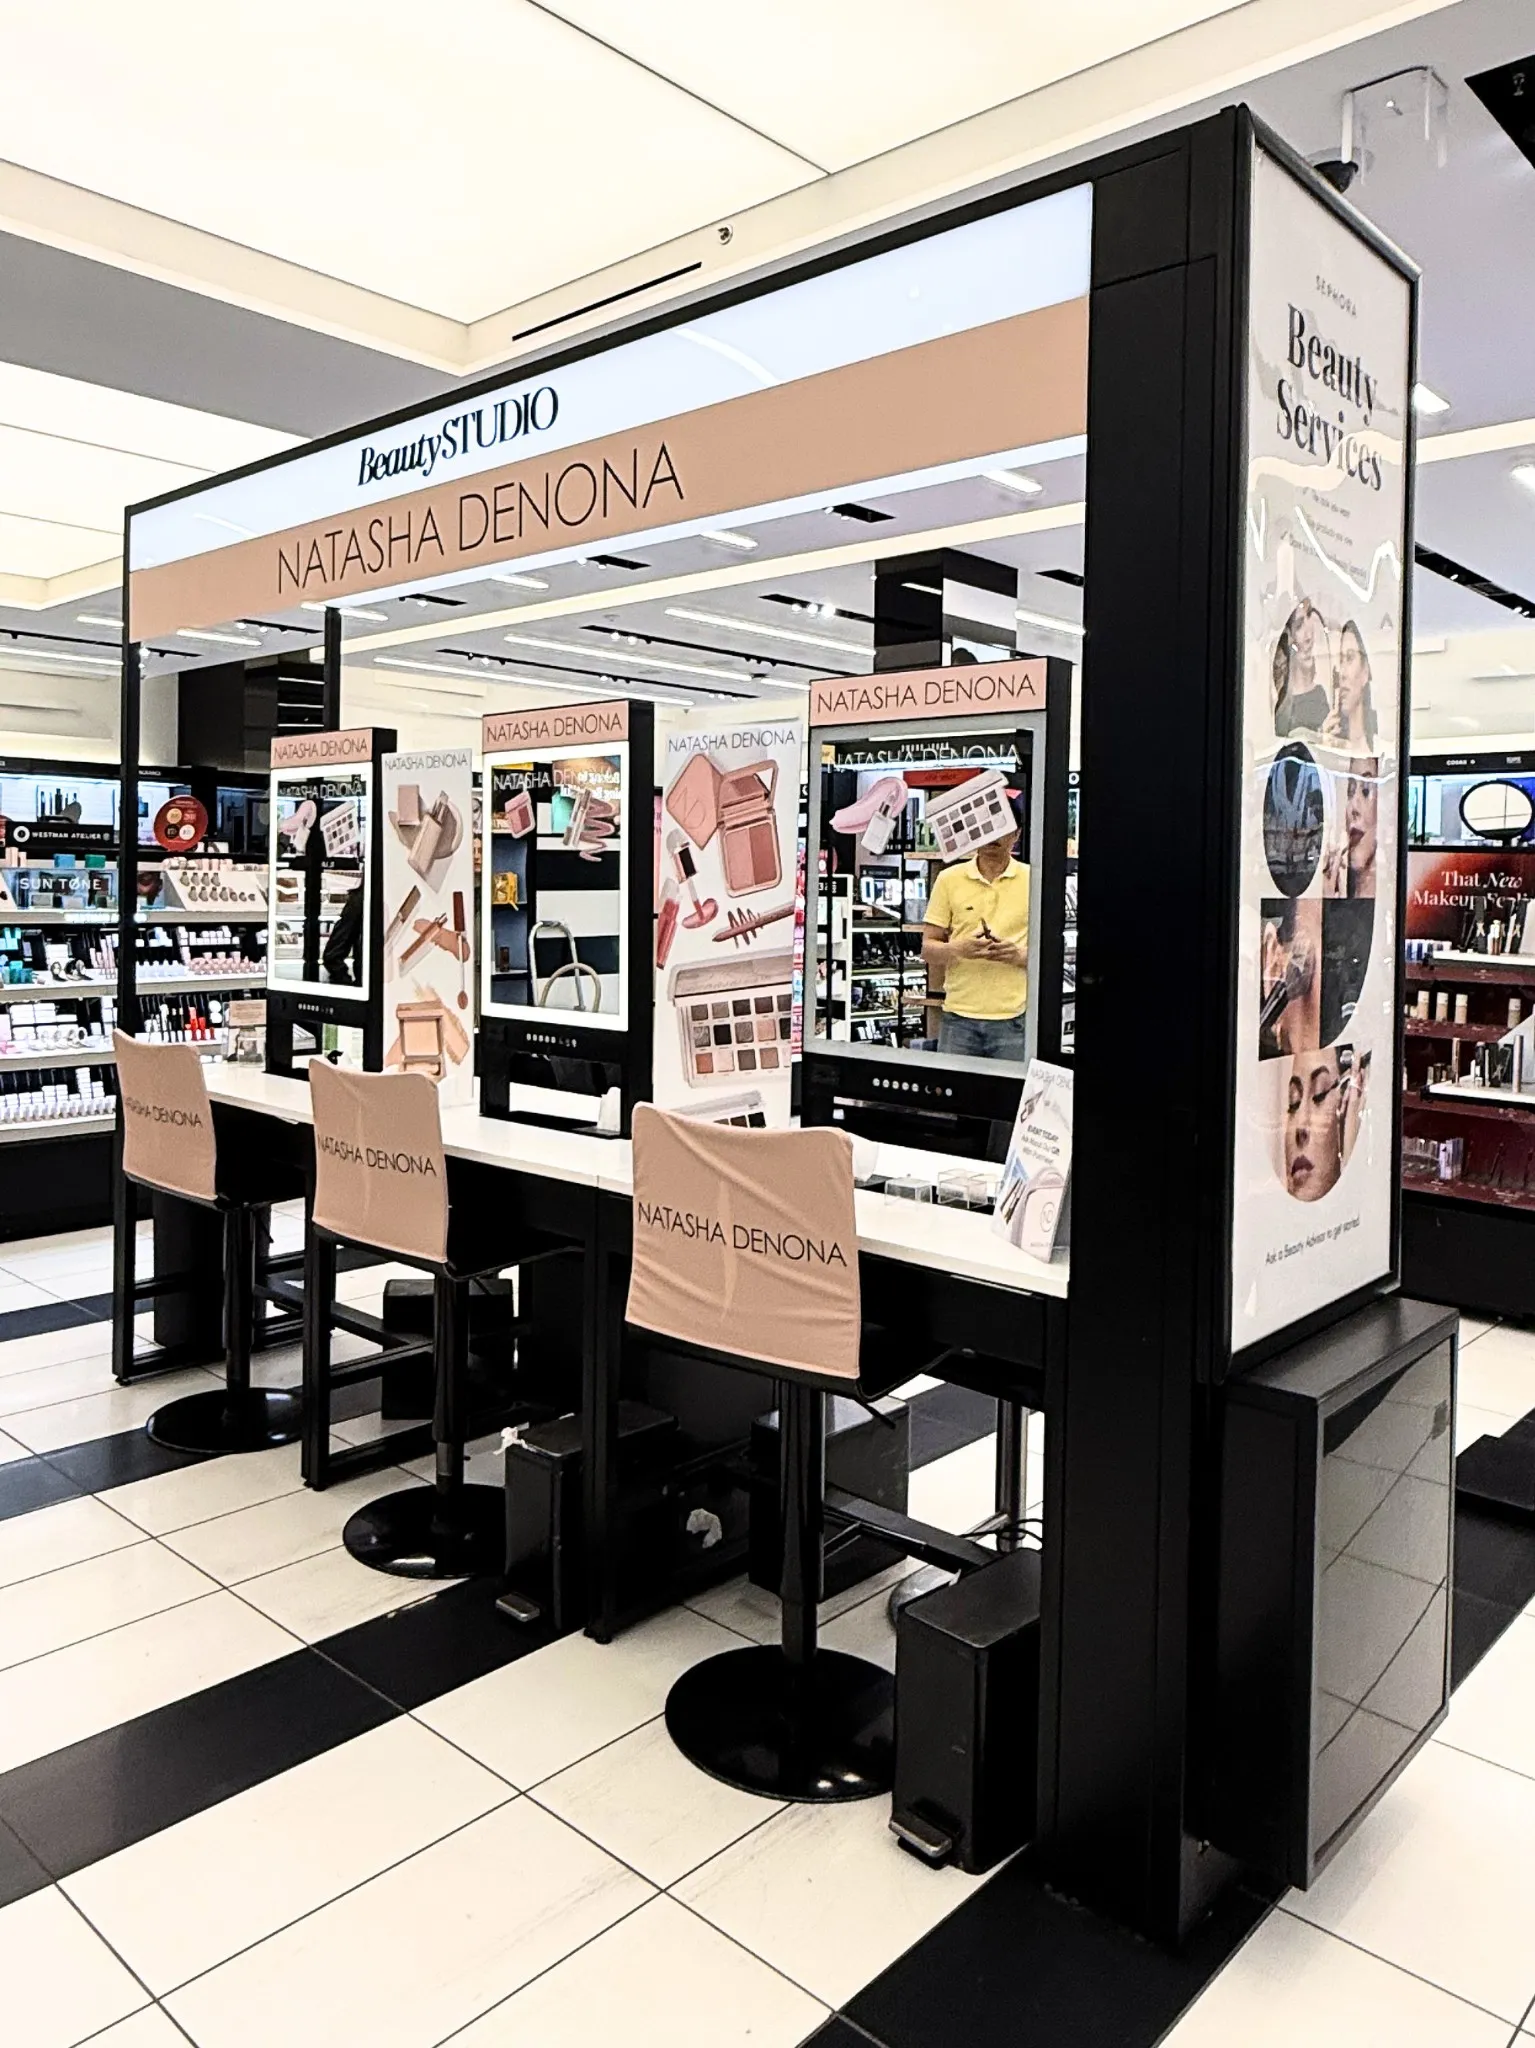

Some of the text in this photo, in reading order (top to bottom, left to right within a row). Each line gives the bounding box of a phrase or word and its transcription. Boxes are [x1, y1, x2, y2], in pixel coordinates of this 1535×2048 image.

[1316, 275, 1357, 317] SEPHORA
[1287, 303, 1378, 426] Beauty
[1276, 378, 1382, 491] Services
[278, 441, 684, 594] NATASHA DENONA
[817, 673, 1036, 713] NATASHA DENONA
[486, 712, 623, 743] NATASHA DENONA
[273, 738, 368, 760] NATASHA DENONA
[668, 730, 796, 752] NATASHA DENONA
[385, 754, 469, 771] NATASHA DENONA
[922, 744, 1023, 767] DENONA
[320, 780, 363, 799] DENONA
[493, 771, 551, 790] NATASHA
[71, 832, 101, 840] ATELIER
[20, 878, 53, 890] SUN
[1441, 871, 1523, 888] That New
[152, 1106, 203, 1128] DENONA
[317, 1134, 437, 1176] NATASHA DENONA
[638, 1202, 848, 1267] NATASHA DENONA
